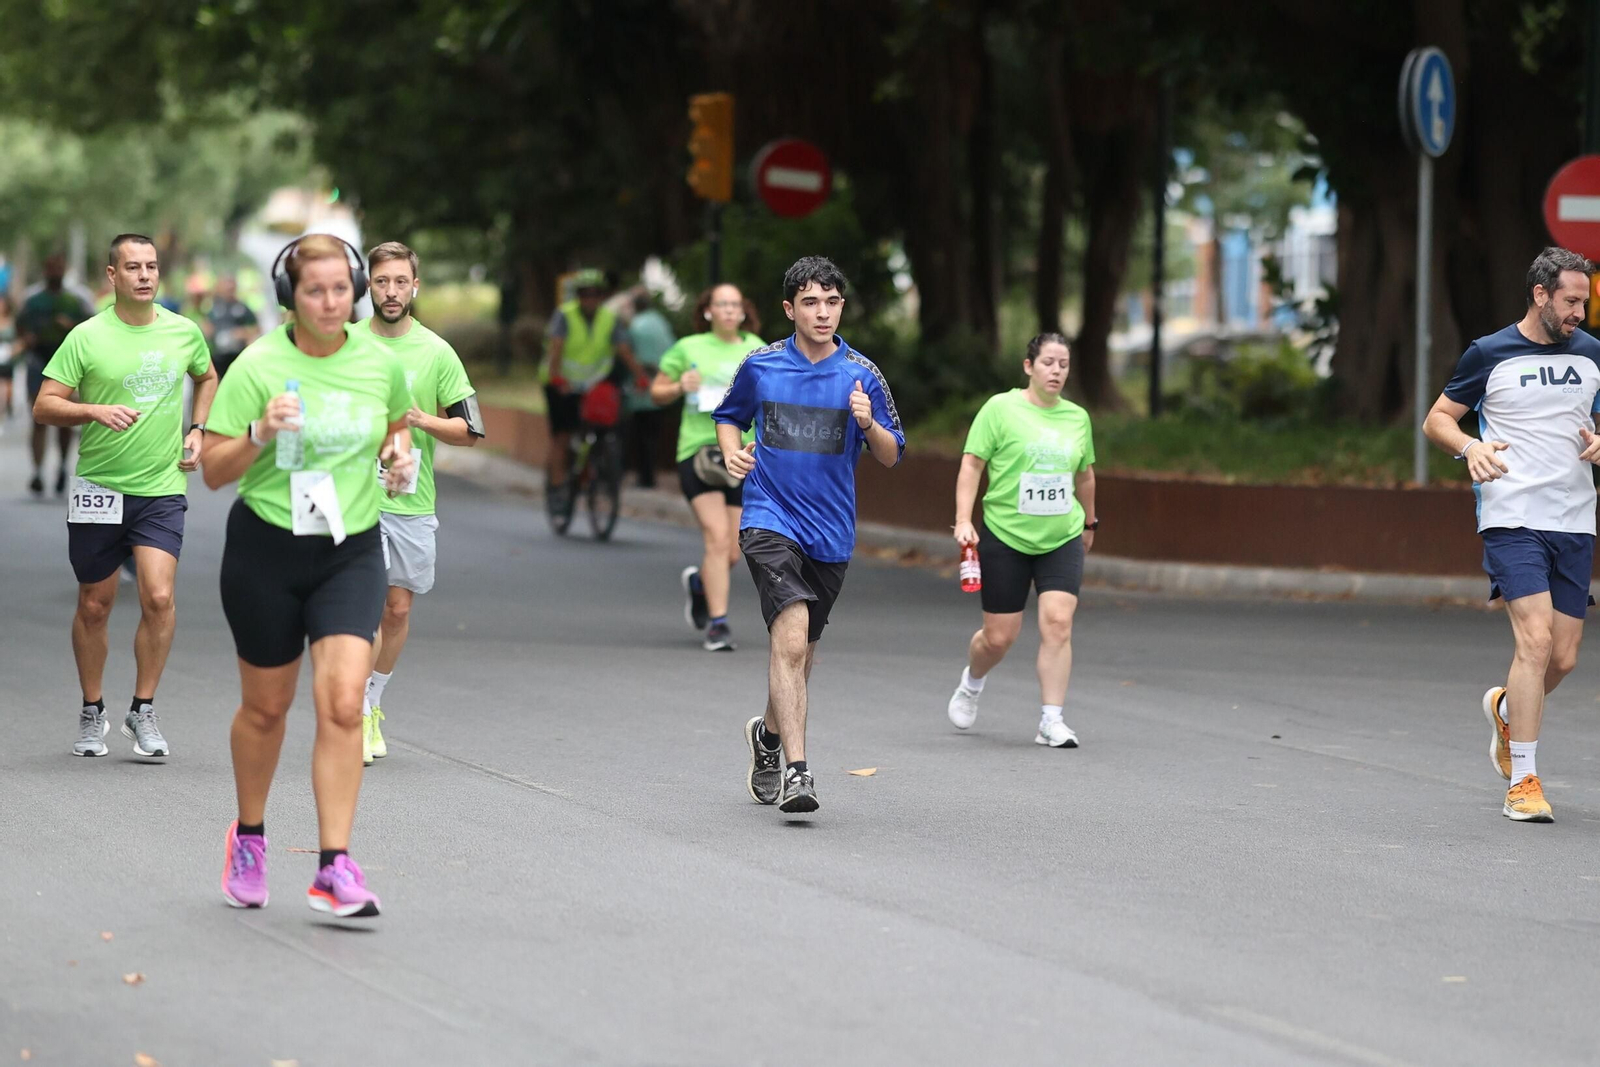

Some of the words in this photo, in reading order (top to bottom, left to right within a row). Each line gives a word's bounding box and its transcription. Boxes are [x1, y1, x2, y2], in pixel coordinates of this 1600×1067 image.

[1519, 365, 1582, 388] FILA
[73, 494, 115, 508] 1537
[1025, 488, 1066, 501] 1181
